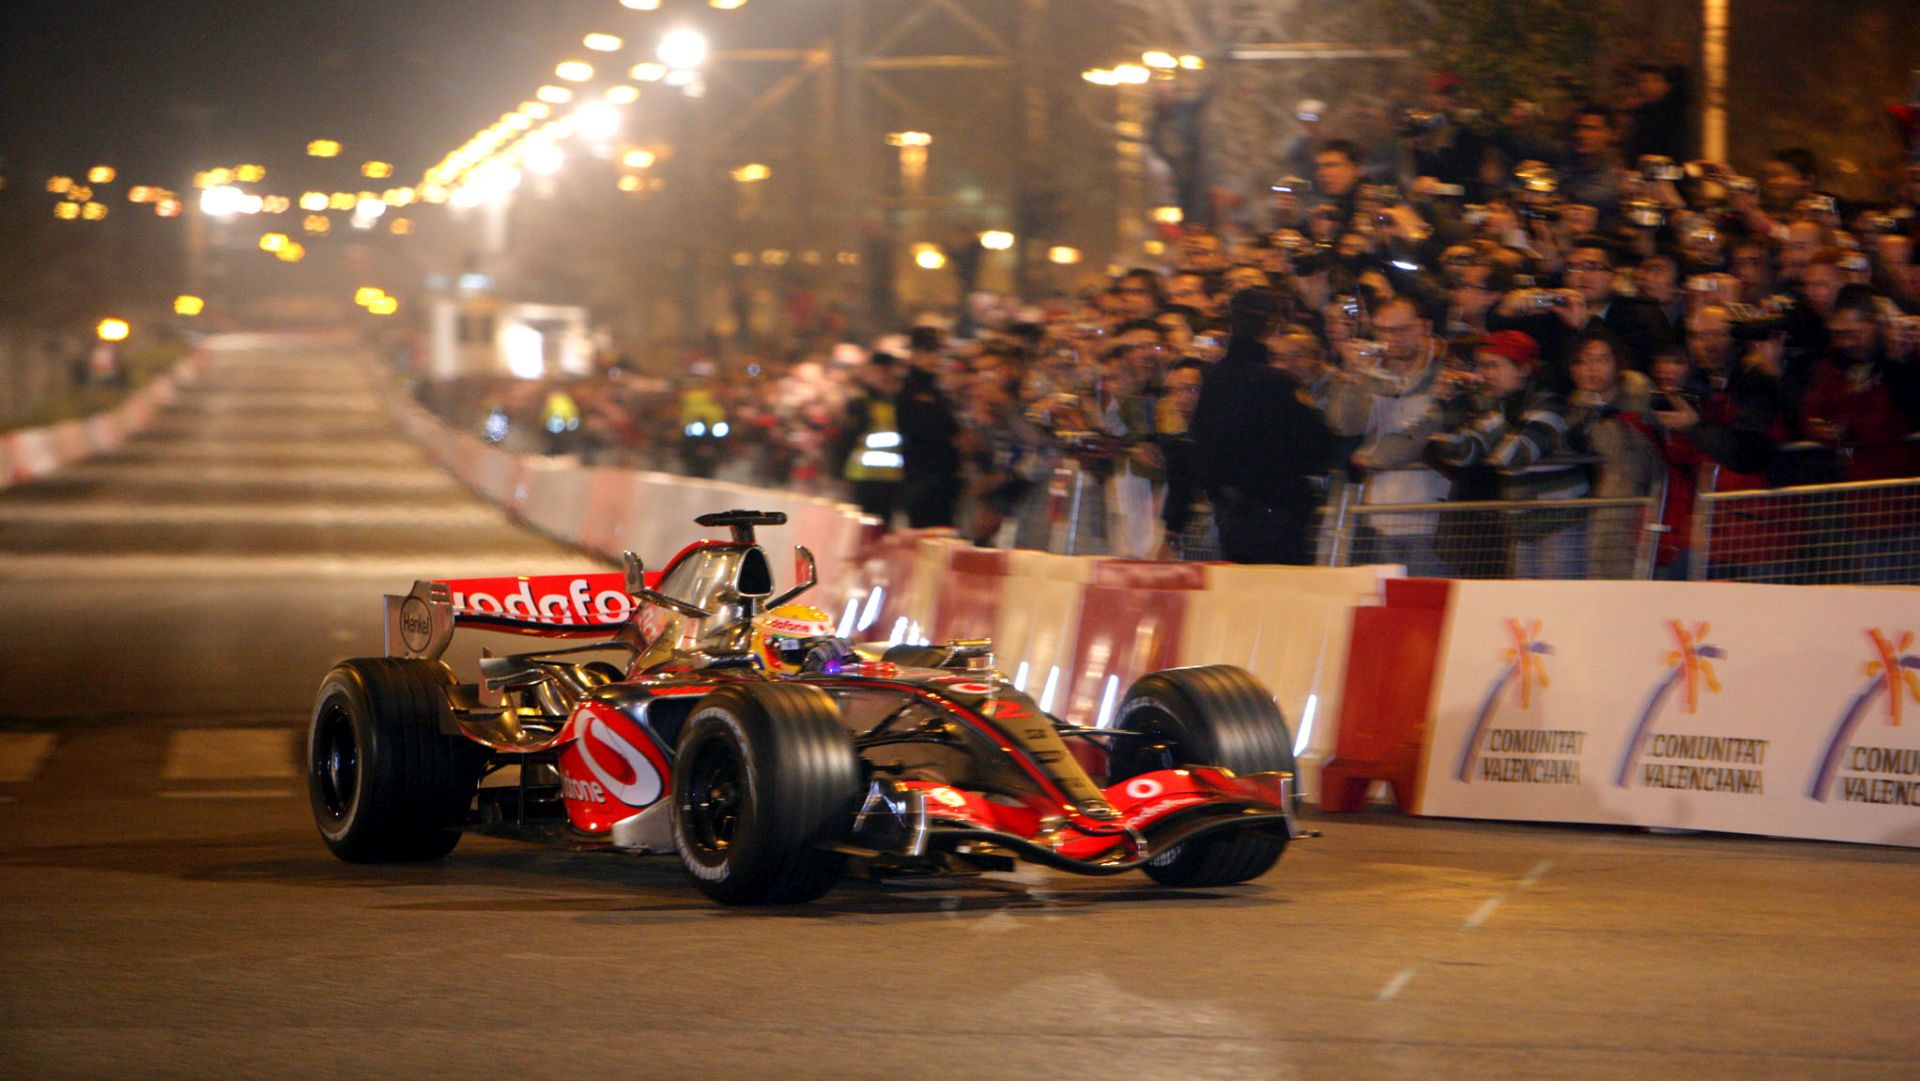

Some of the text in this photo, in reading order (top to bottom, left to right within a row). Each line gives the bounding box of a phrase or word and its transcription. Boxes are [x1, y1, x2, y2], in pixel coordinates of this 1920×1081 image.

[452, 578, 642, 625] odafo
[403, 611, 429, 635] Henkel
[1489, 728, 1586, 754] COMUNITAT
[1652, 733, 1770, 765] COMUNITAT
[1483, 757, 1581, 785] VALENCIANA
[1852, 745, 1920, 776] COMU
[1644, 763, 1765, 795] VALENCIANA
[1843, 776, 1920, 807] VALENC
